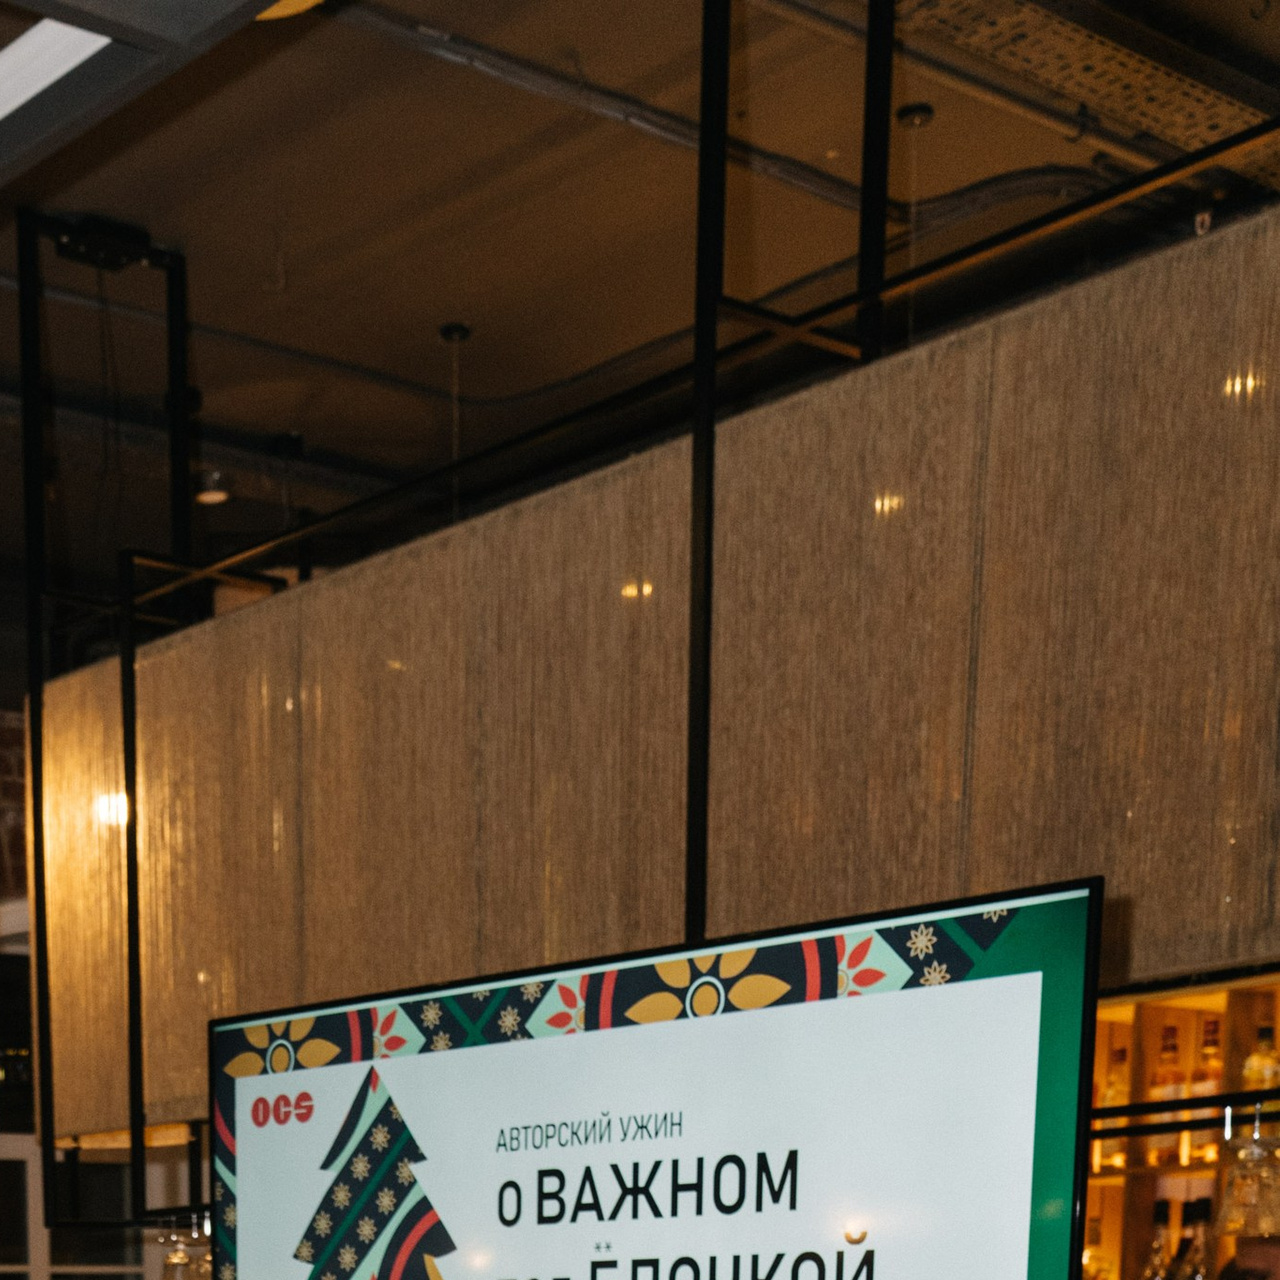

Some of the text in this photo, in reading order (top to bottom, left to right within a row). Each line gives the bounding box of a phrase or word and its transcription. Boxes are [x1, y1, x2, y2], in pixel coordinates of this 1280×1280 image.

[251, 1091, 314, 1129] OCS
[497, 1111, 683, 1152] АВТОРСКИЙ УЖИН
[536, 1149, 798, 1225] ВАЖНОМ
